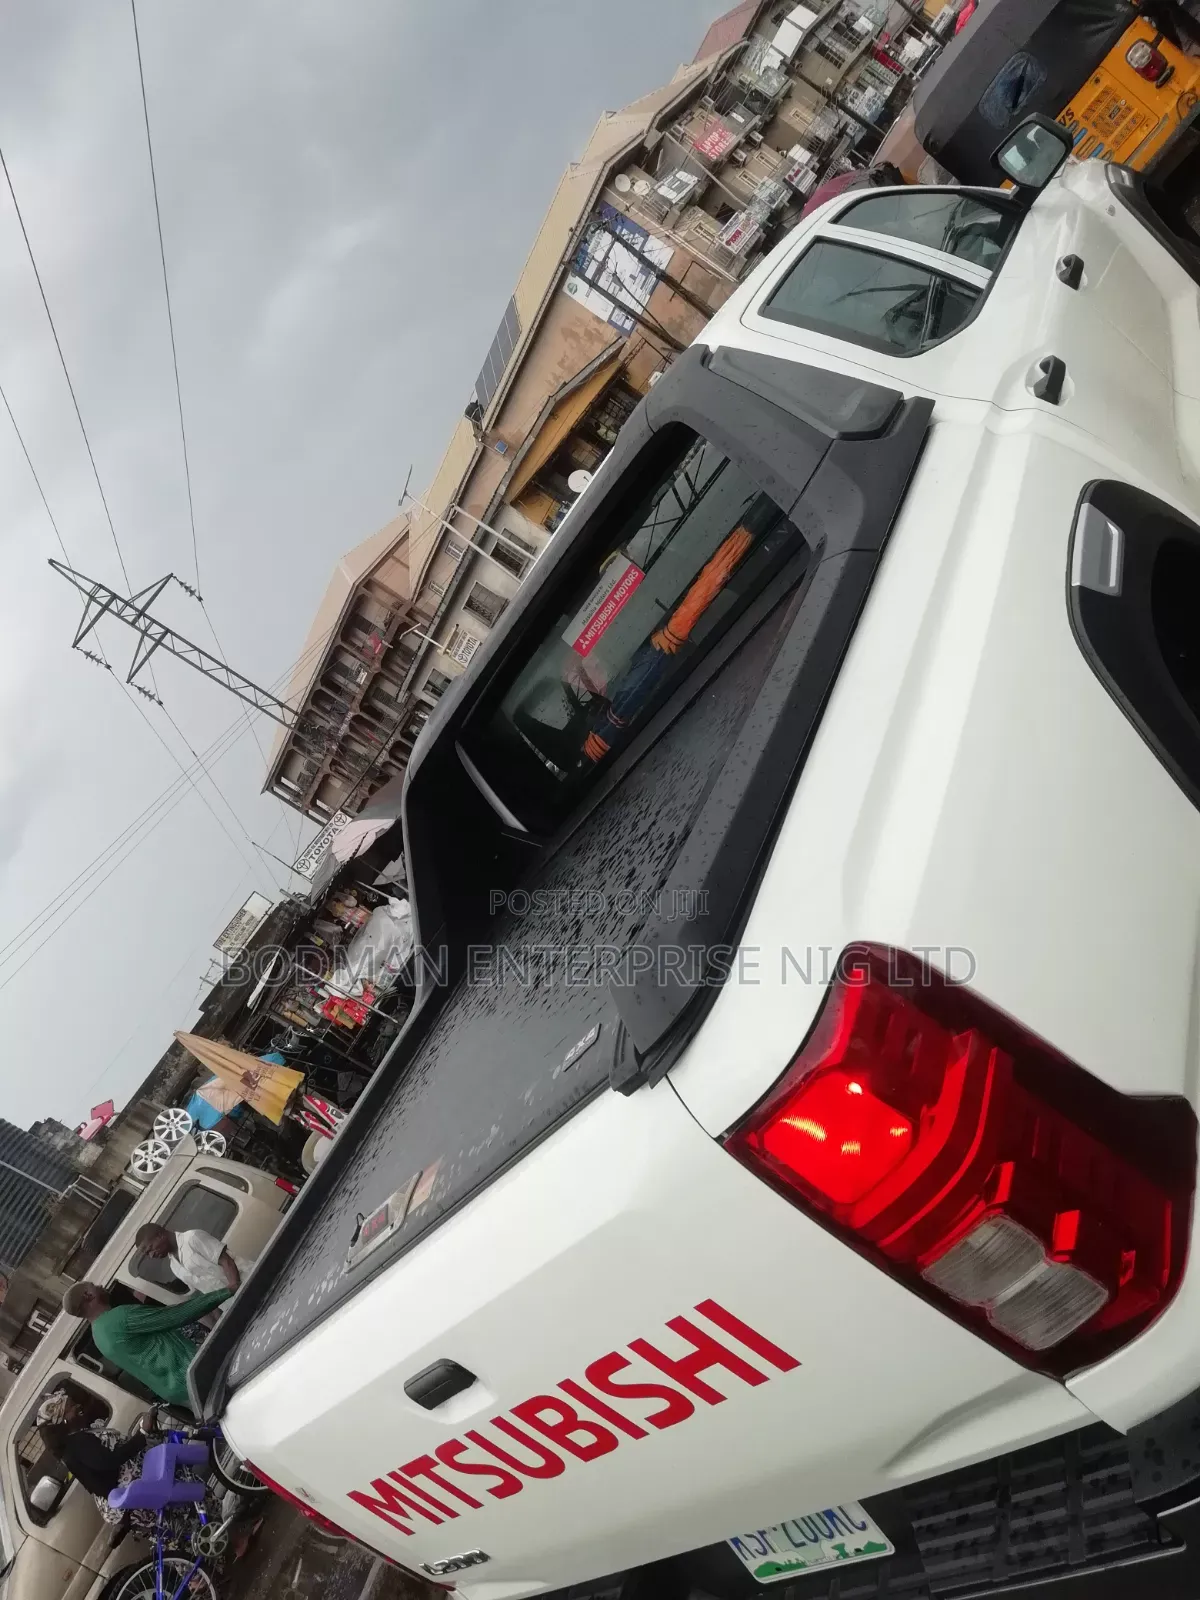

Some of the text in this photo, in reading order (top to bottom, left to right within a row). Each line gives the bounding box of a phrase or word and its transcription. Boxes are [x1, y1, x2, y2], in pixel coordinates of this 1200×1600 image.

[699, 131, 720, 153] LAPTOP
[708, 139, 730, 160] STORE
[585, 600, 616, 641] MITSUBISHI
[613, 568, 639, 602] MOTORS
[595, 587, 610, 607] Motors
[462, 636, 477, 656] TOYOTA
[309, 827, 339, 861] TOYOTA
[346, 1298, 802, 1536] MITSUBISHI
